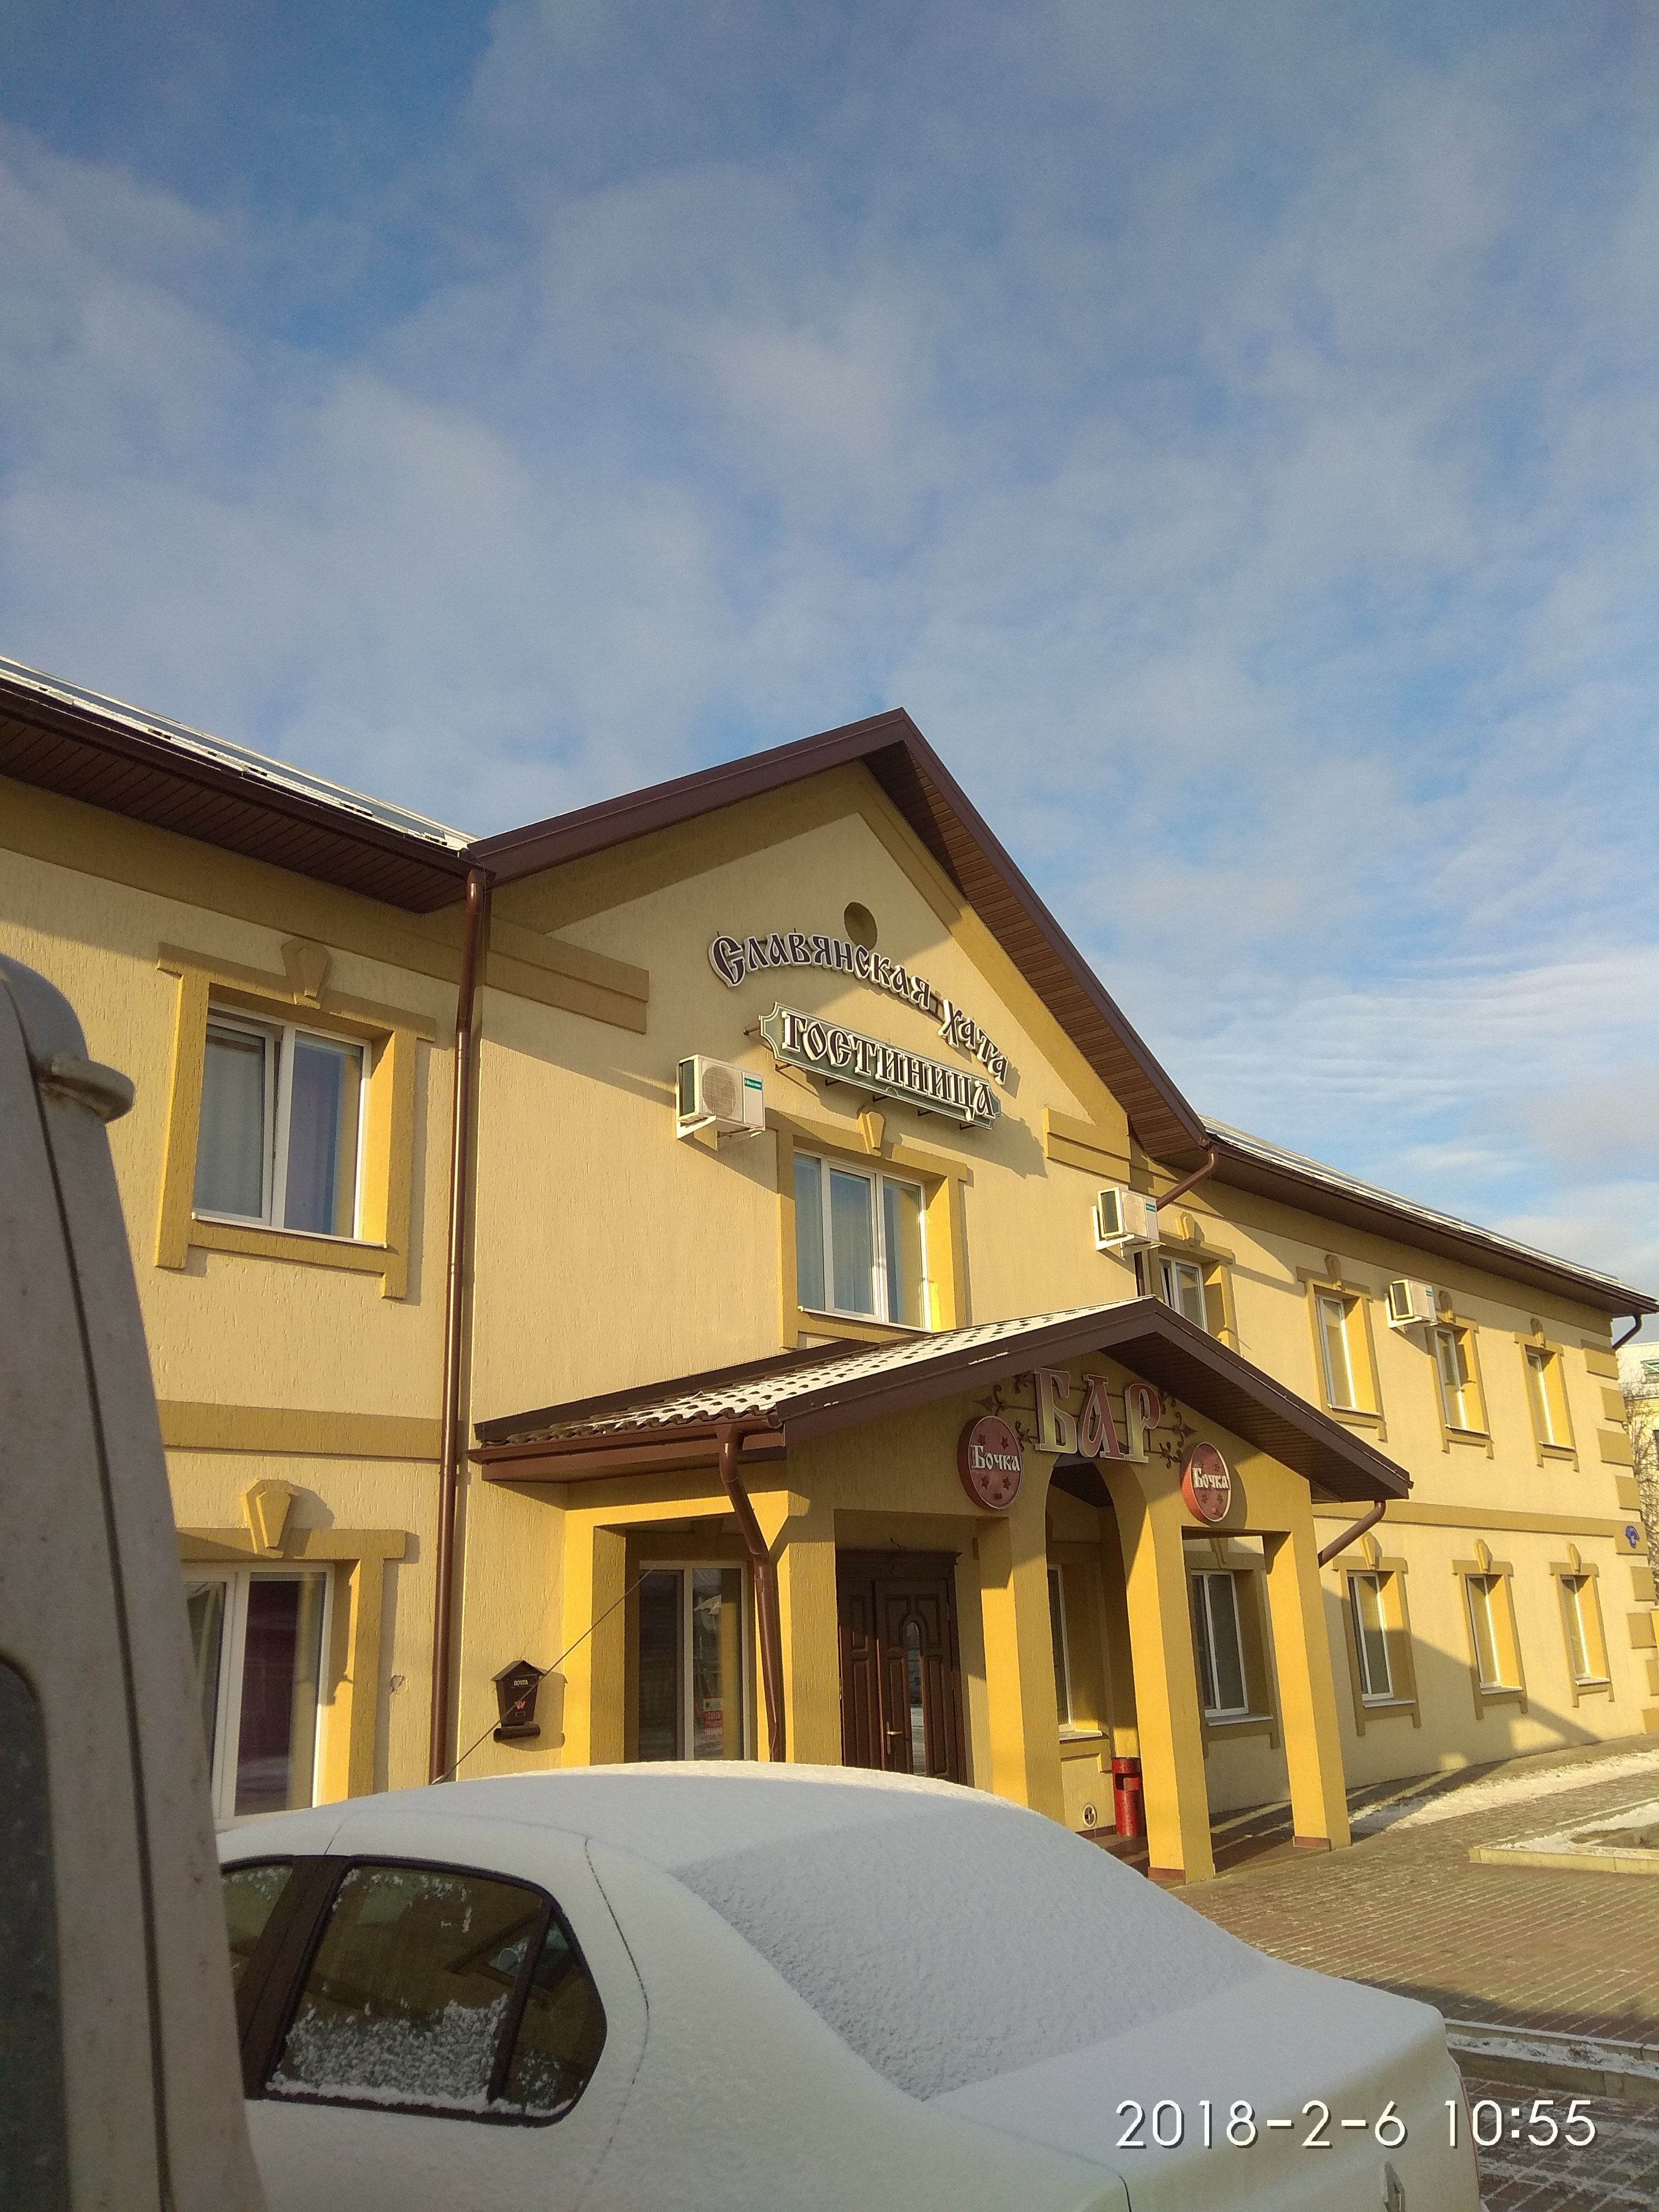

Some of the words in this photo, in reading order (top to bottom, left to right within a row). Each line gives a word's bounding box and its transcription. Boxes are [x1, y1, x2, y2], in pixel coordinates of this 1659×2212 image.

[781, 1010, 996, 1121] ГОСТИНИЦА
[1034, 1367, 1161, 1463] БАР
[970, 1444, 1020, 1472] Бочка
[1192, 1467, 1229, 1489] Бочка
